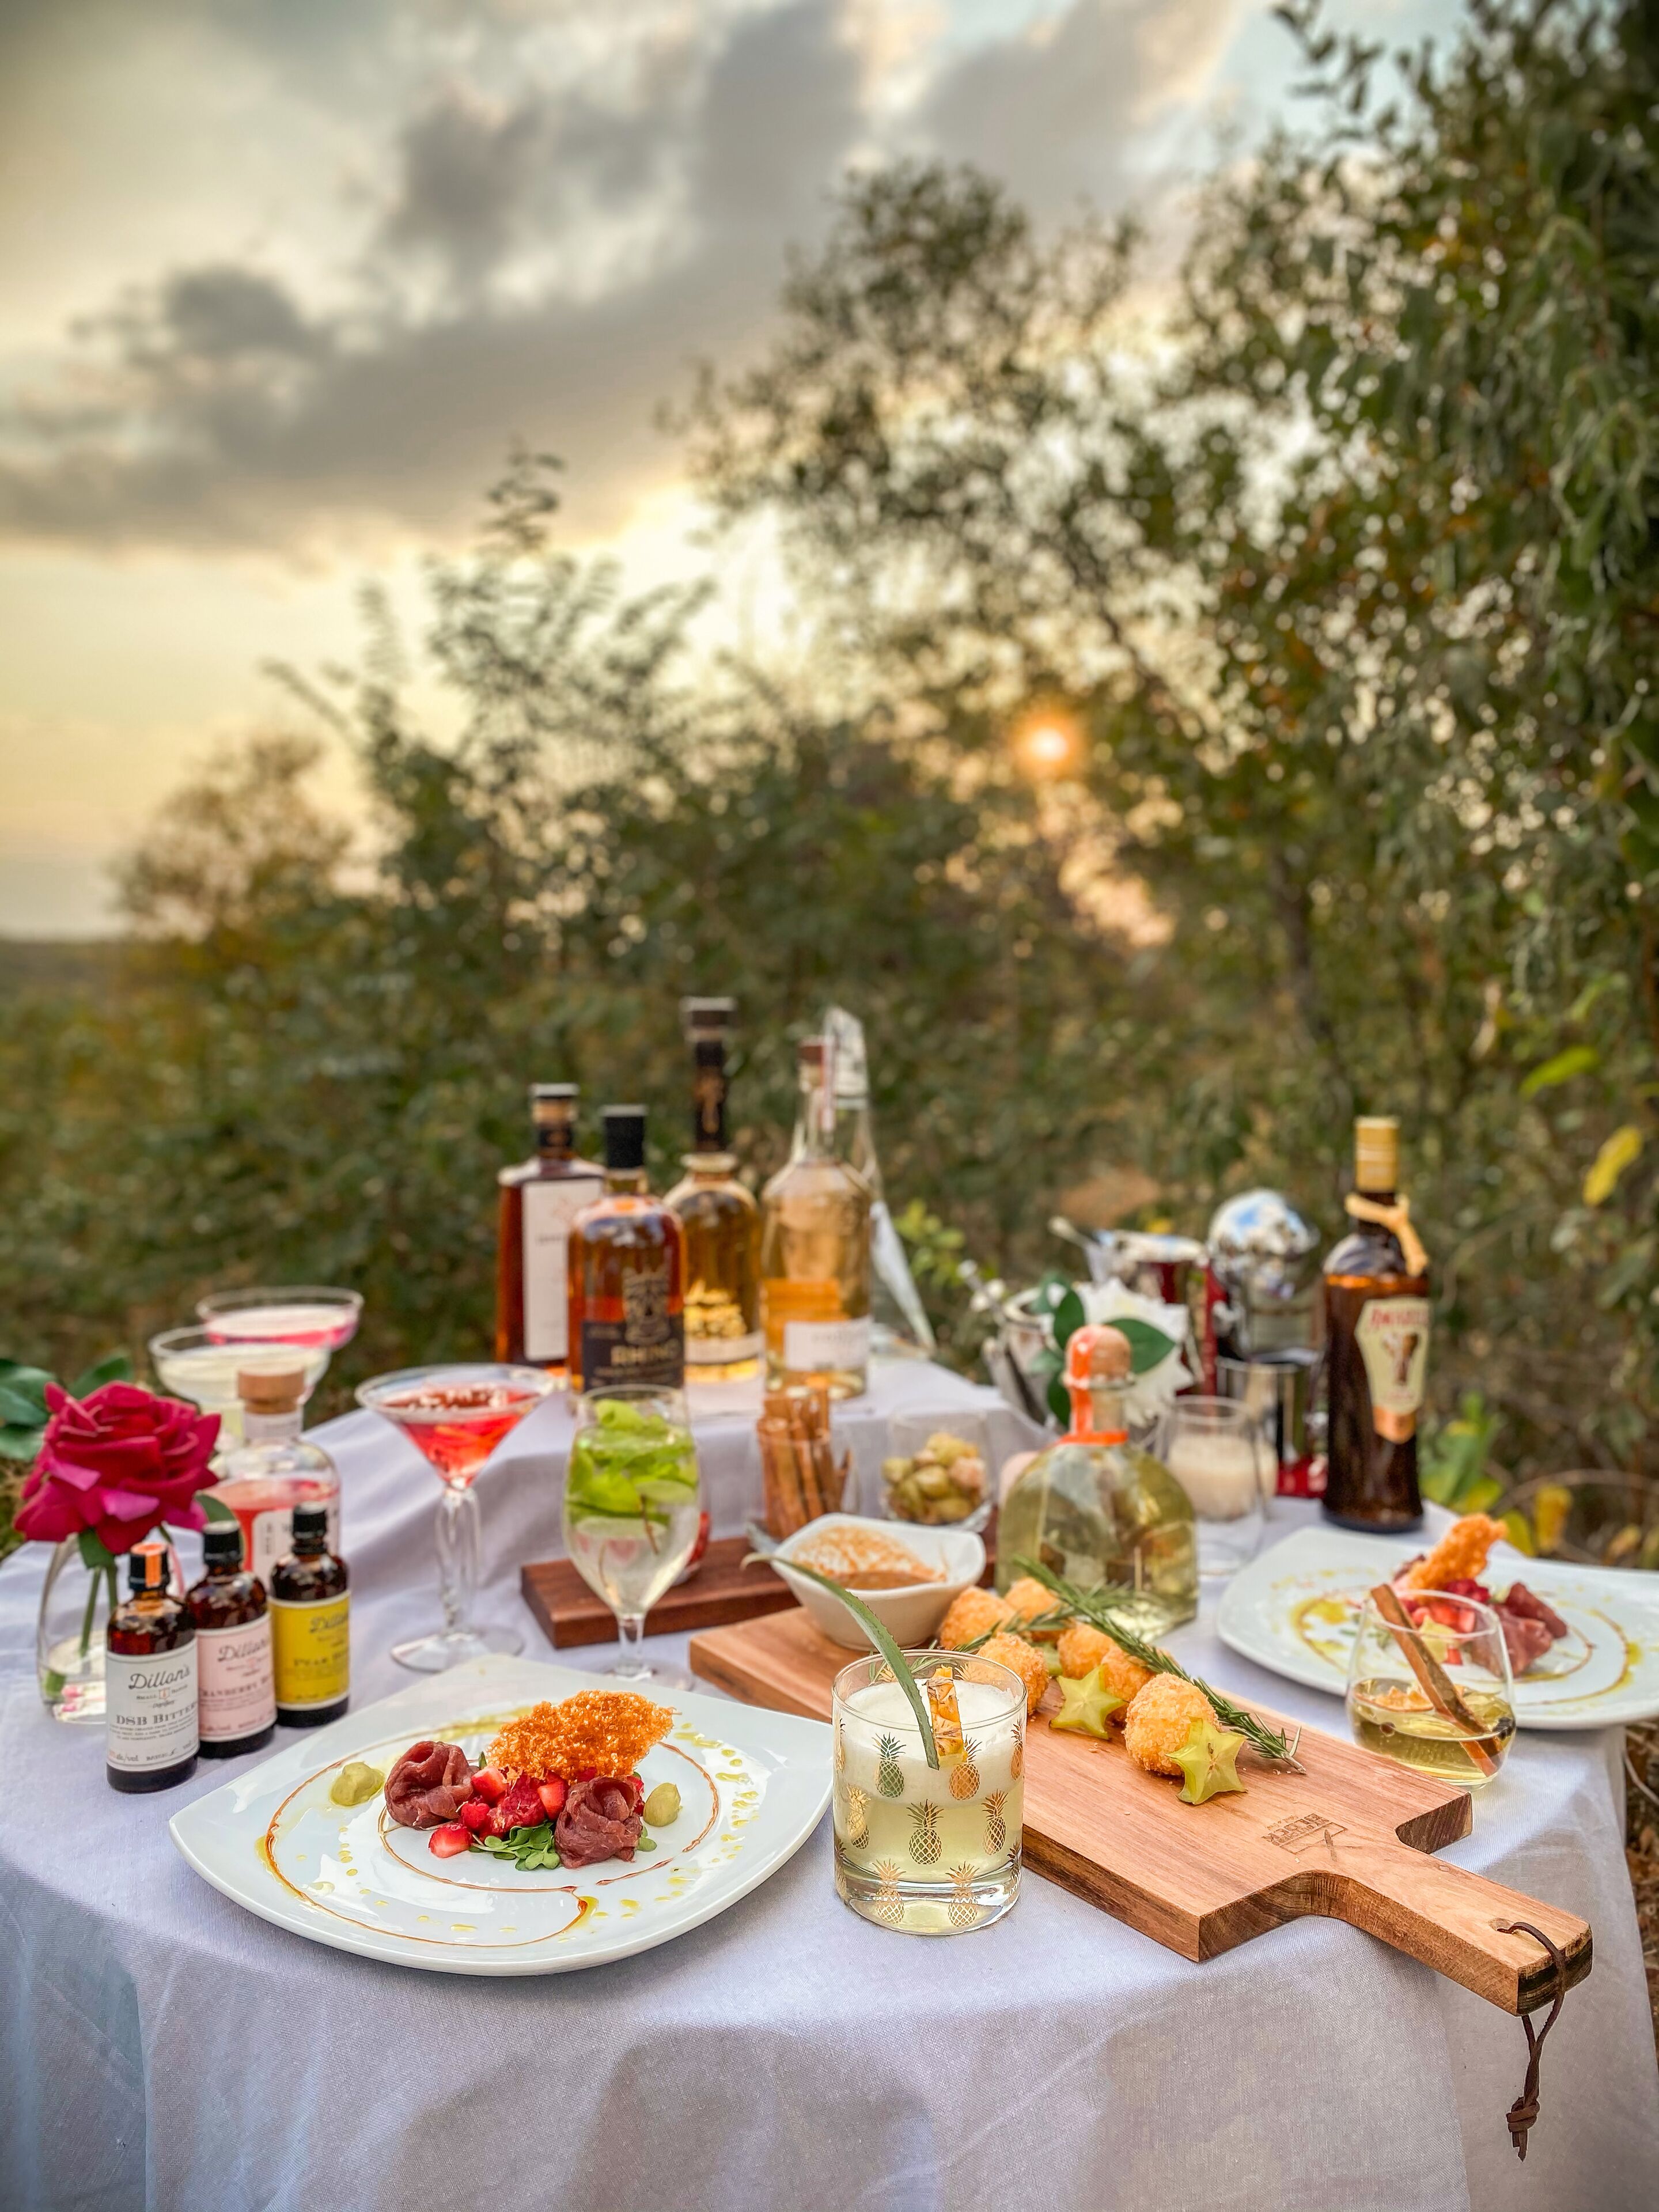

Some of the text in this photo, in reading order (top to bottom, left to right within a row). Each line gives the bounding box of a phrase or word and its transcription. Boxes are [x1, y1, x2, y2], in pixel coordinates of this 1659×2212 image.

[128, 1664, 190, 1690] Dillon's
[116, 1714, 147, 1725] DSB
[153, 1701, 198, 1724] BITTER
[1262, 1813, 1320, 1842] BLOCK
